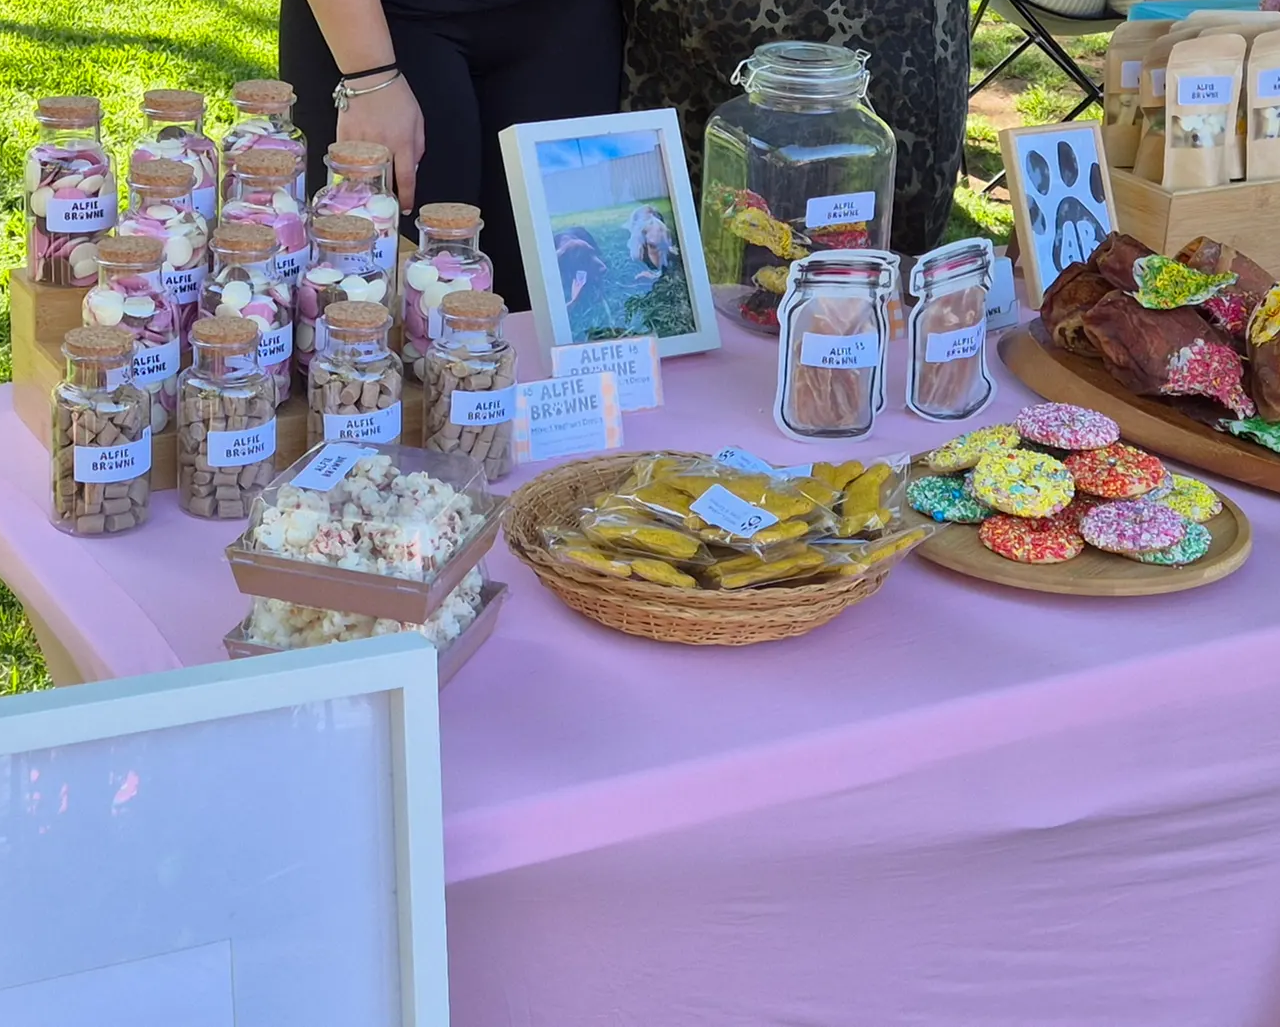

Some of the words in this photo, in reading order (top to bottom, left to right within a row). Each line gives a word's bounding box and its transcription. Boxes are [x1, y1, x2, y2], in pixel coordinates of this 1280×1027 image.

[71, 200, 99, 211] ALFIE
[833, 201, 855, 211] ALFIE
[166, 274, 192, 285] ALFIE
[580, 344, 624, 365] ALFIE
[829, 346, 852, 356] ALFIE
[133, 354, 160, 366] ALFIE
[132, 362, 167, 376] ROWNE
[541, 378, 585, 401] ALFIE
[475, 400, 501, 411] ALFIE
[530, 394, 599, 422] BROWNE
[346, 417, 375, 429] ALFIE
[233, 434, 261, 448] ALFIE
[99, 448, 130, 461] ALFIE
